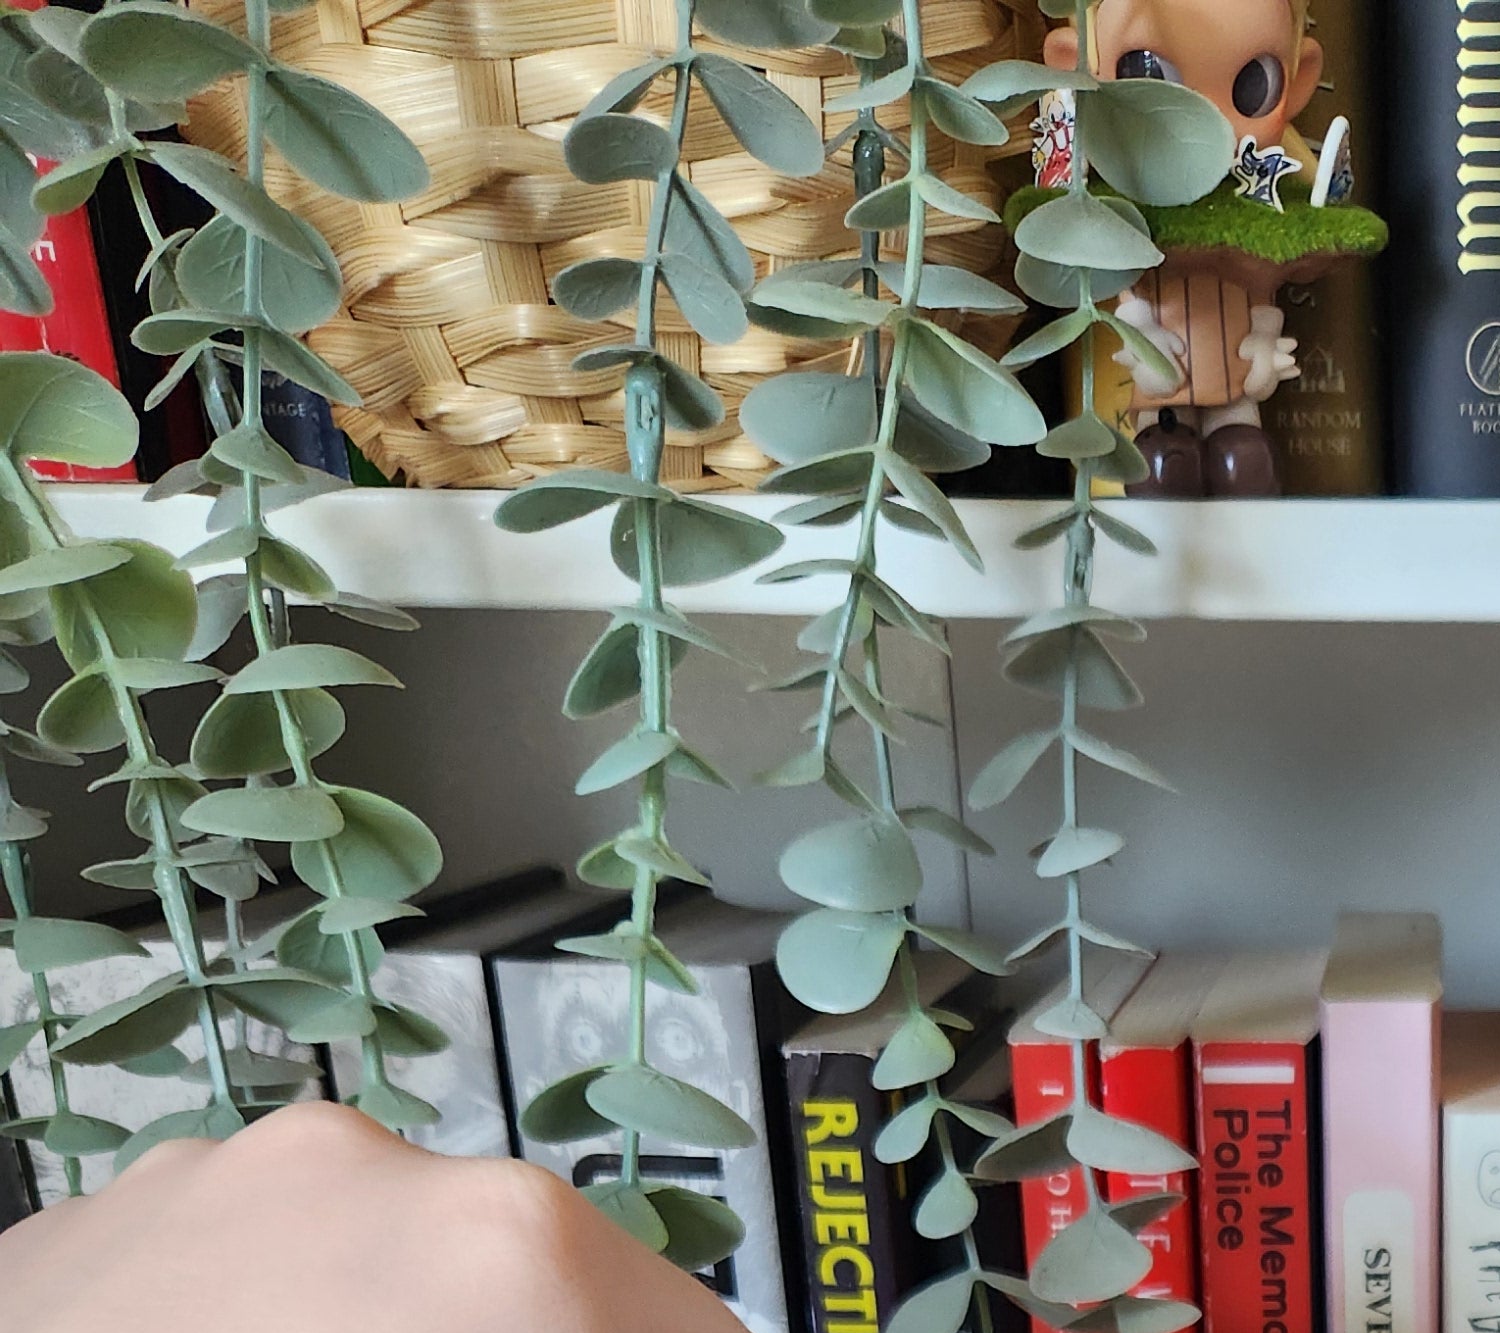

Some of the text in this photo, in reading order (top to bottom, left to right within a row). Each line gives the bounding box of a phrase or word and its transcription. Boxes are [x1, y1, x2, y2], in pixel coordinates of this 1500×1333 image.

[1278, 411, 1361, 429] RANDOM
[1213, 1108, 1248, 1252] Police
[1256, 1099, 1292, 1189] The
